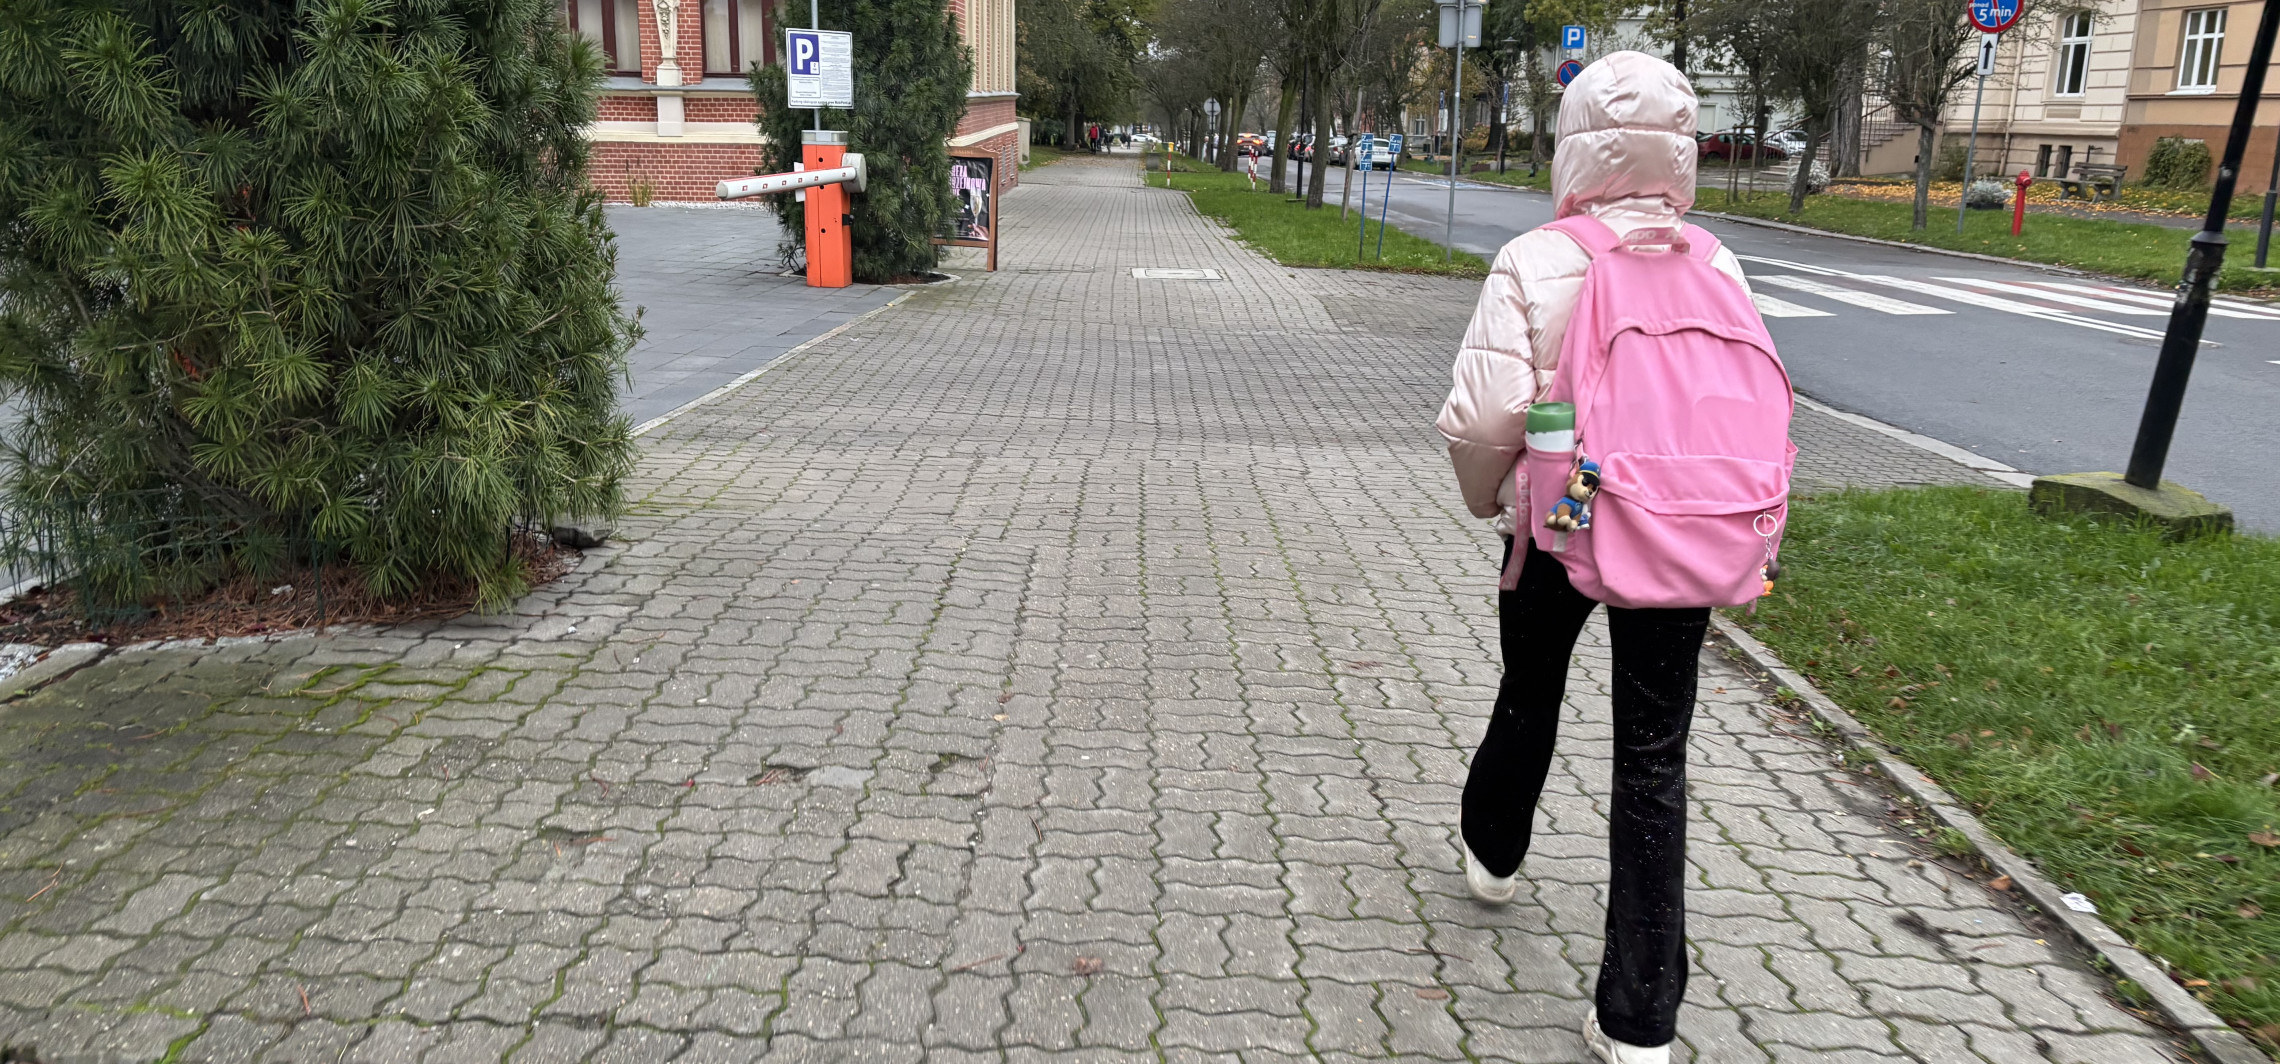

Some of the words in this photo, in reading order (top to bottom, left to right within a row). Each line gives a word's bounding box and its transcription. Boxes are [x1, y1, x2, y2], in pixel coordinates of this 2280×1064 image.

[1979, 9, 1988, 22] 5
[1990, 6, 2012, 17] min
[1567, 28, 1581, 46] P
[796, 37, 814, 70] P
